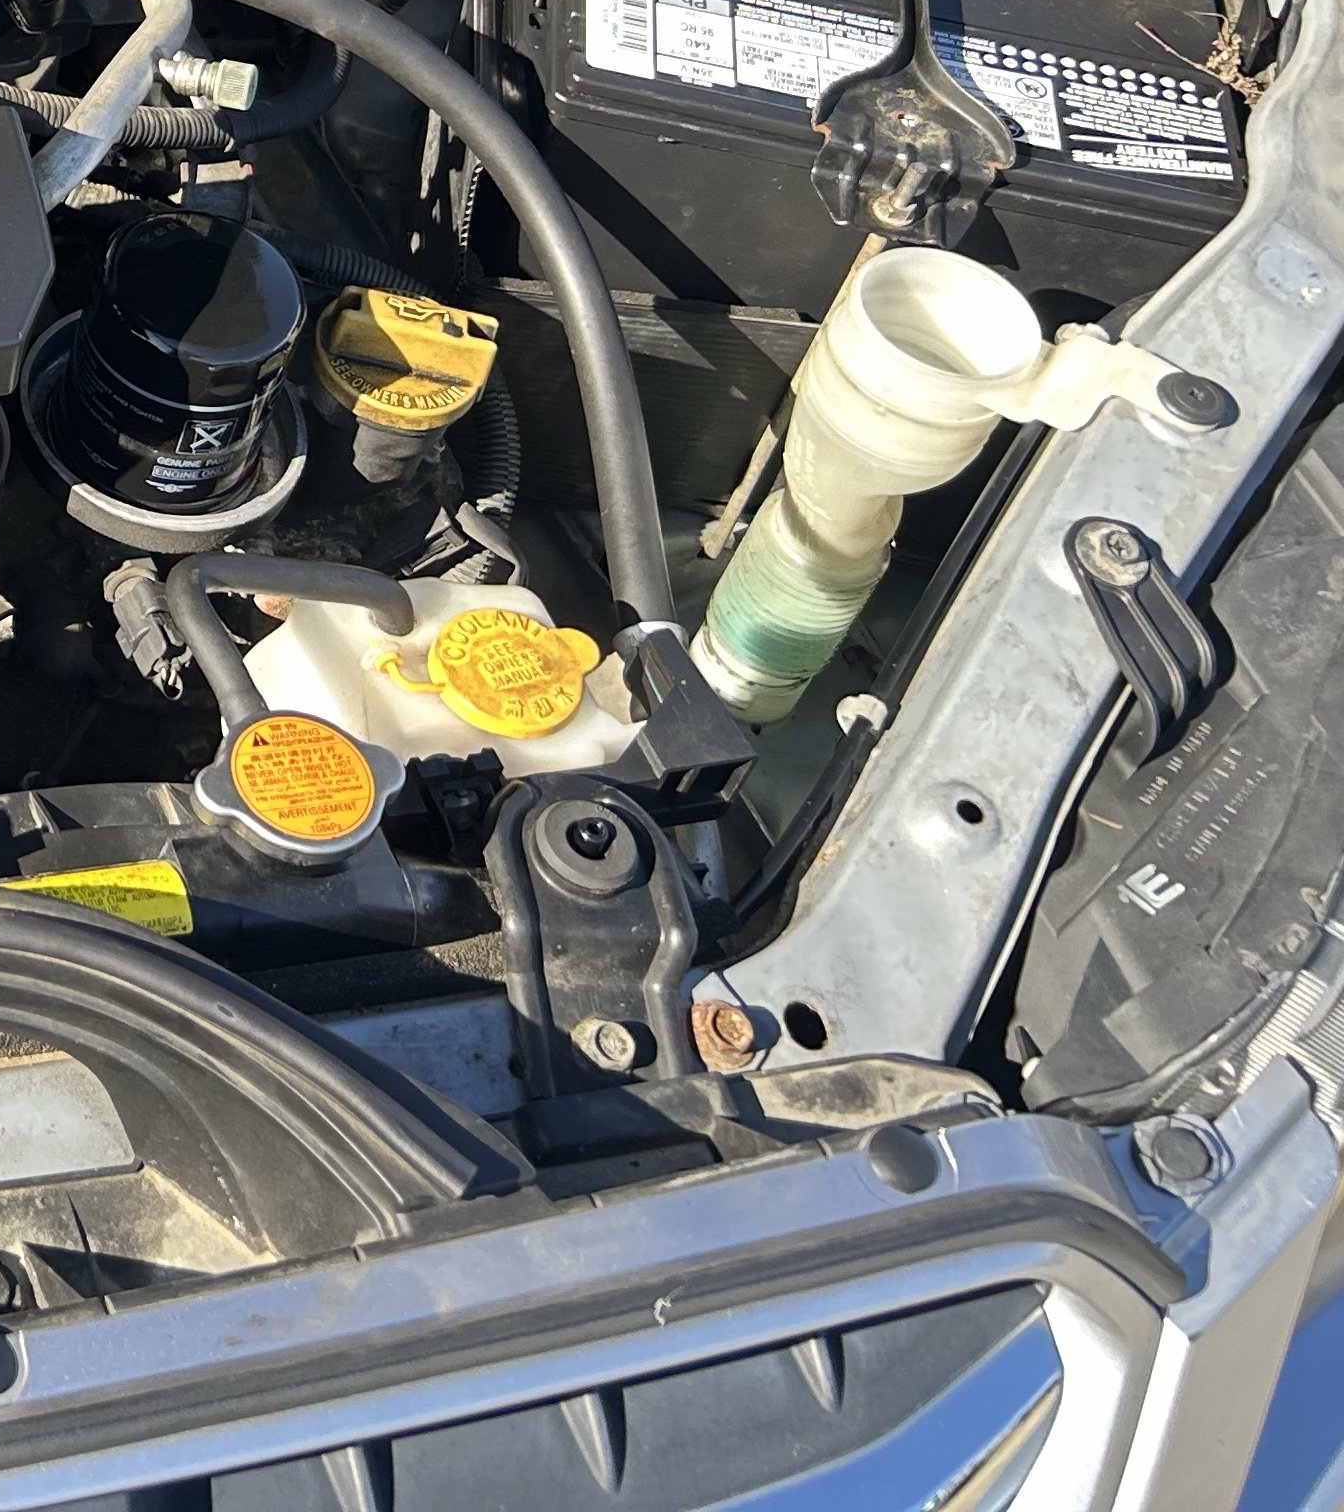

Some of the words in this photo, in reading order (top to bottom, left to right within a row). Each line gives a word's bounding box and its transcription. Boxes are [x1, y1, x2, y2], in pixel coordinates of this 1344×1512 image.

[680, 22, 697, 34] RC
[685, 38, 711, 51] 640
[1115, 144, 1187, 160] BATTERY
[1071, 149, 1233, 175] MAINTENANCE-FREE
[330, 358, 354, 380] SEE
[351, 377, 411, 408] OWNER'S
[413, 385, 467, 409] MANUAL
[157, 457, 202, 467] GENUINE
[154, 467, 198, 478] ENGINE
[483, 642, 514, 659] SEE
[484, 650, 542, 674] OWNERS
[491, 665, 551, 689] MANUAL
[269, 728, 321, 740] WARNING
[278, 801, 357, 819] AVERTISSEMENT
[1118, 863, 1186, 916] 1E
